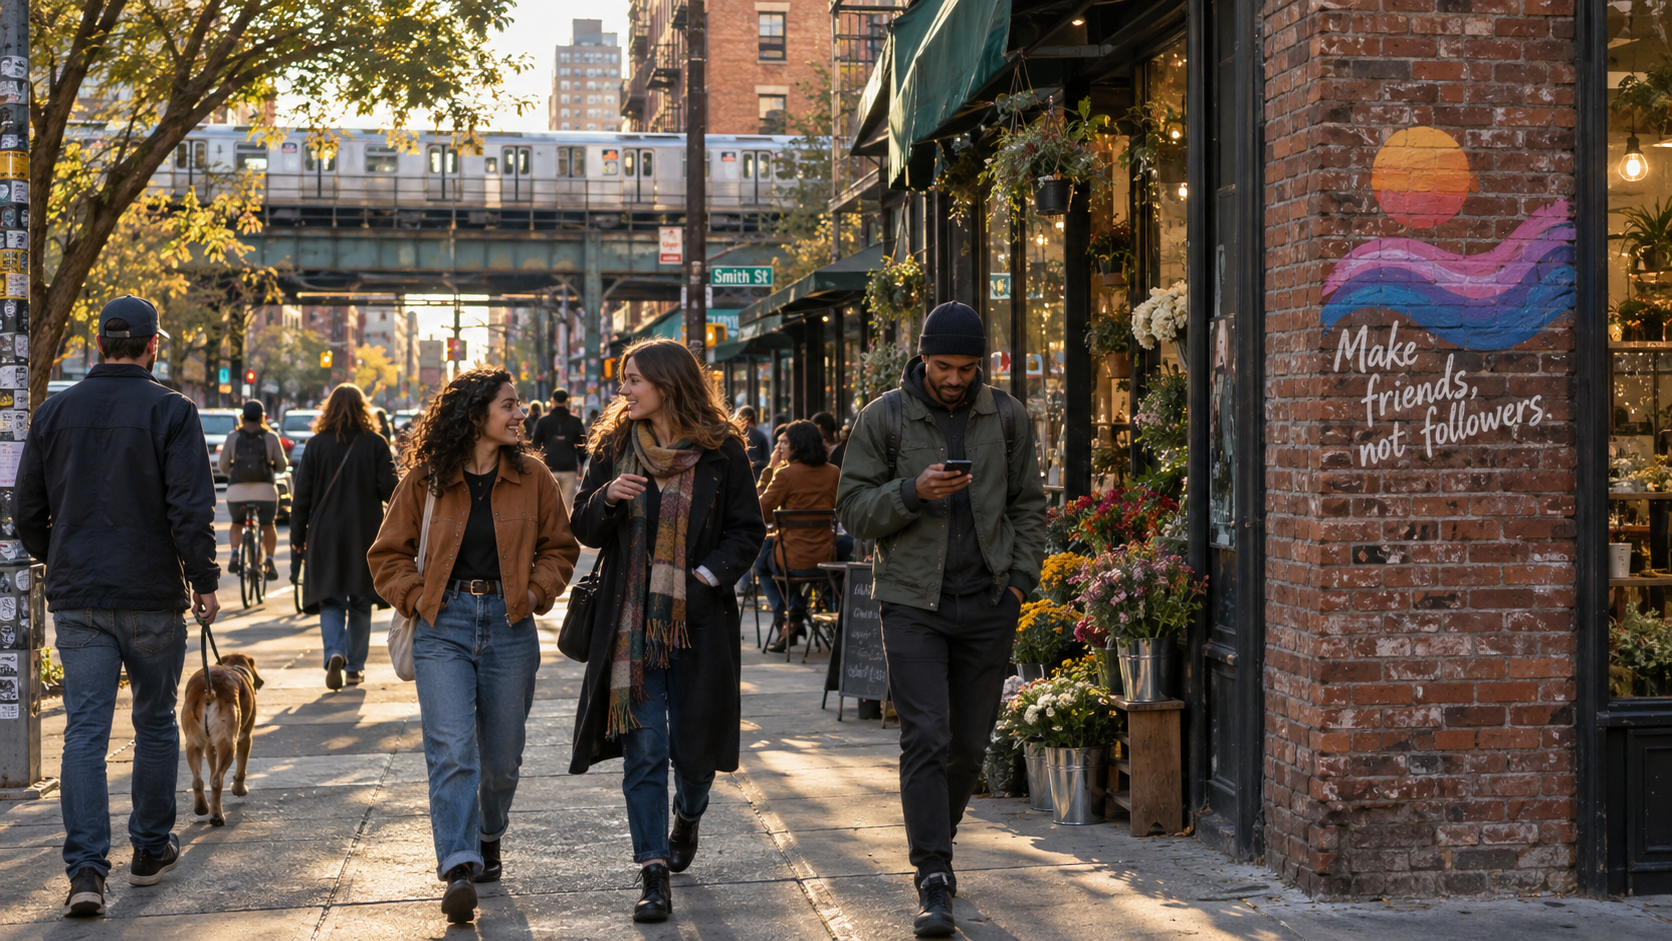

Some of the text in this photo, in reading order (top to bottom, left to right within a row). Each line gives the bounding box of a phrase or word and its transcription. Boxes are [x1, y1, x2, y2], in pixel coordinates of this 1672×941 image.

[715, 269, 750, 283] Smith
[754, 269, 768, 284] St
[1333, 320, 1418, 373] Make
[1361, 353, 1477, 427] friends,
[1360, 394, 1553, 467] not followers.
